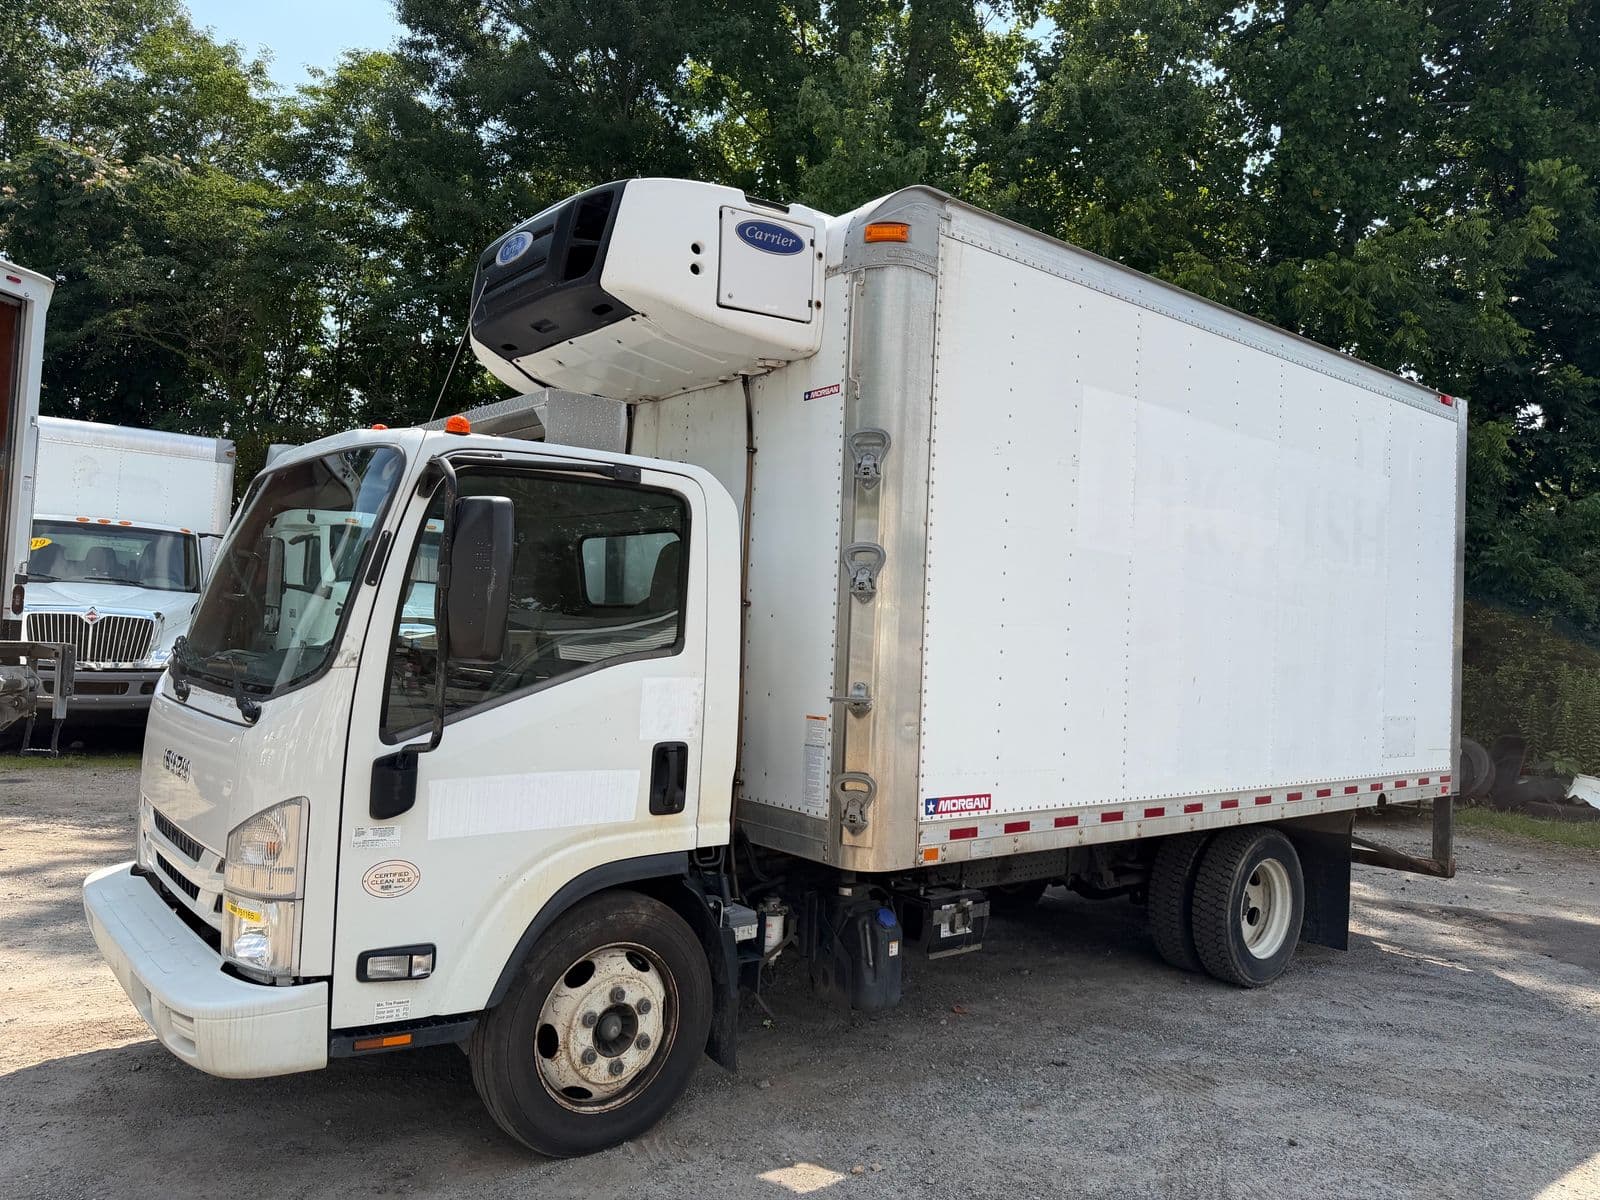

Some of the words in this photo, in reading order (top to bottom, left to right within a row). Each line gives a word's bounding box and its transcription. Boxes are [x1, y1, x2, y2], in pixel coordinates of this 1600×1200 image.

[745, 225, 796, 248] Carrier
[810, 385, 839, 398] MORGAN
[938, 797, 989, 812] MORGAN
[374, 871, 410, 879] CERTIFIED
